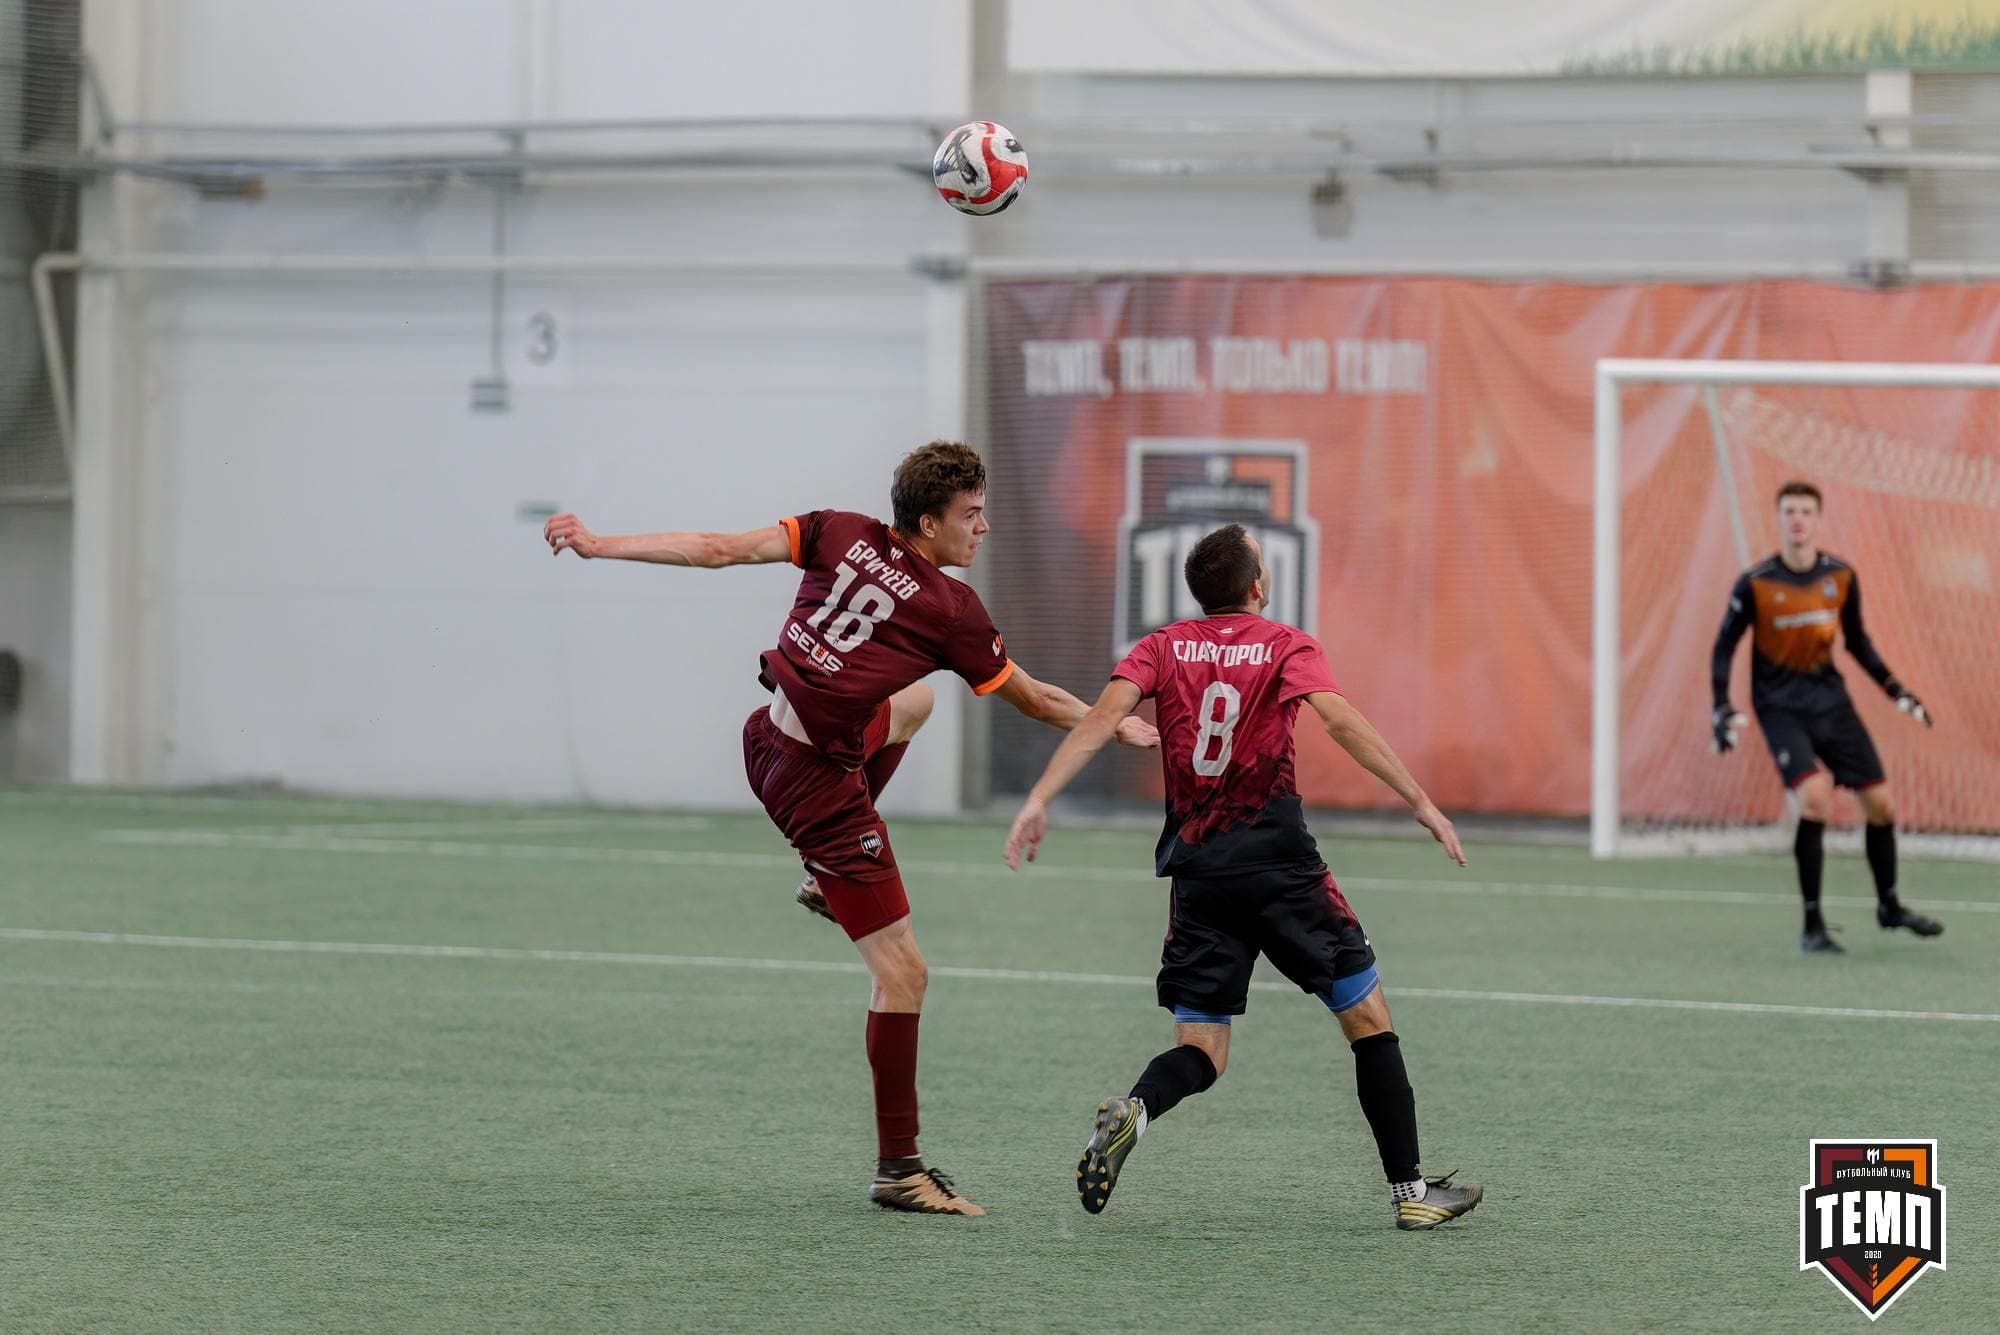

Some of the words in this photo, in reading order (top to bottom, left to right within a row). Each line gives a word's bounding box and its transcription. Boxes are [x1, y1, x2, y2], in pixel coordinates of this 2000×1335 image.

[526, 309, 558, 367] 3
[845, 539, 920, 601] БРИЧЕЕВ
[806, 561, 895, 653] 18
[787, 622, 844, 672] SEUS
[1192, 681, 1241, 777] 8
